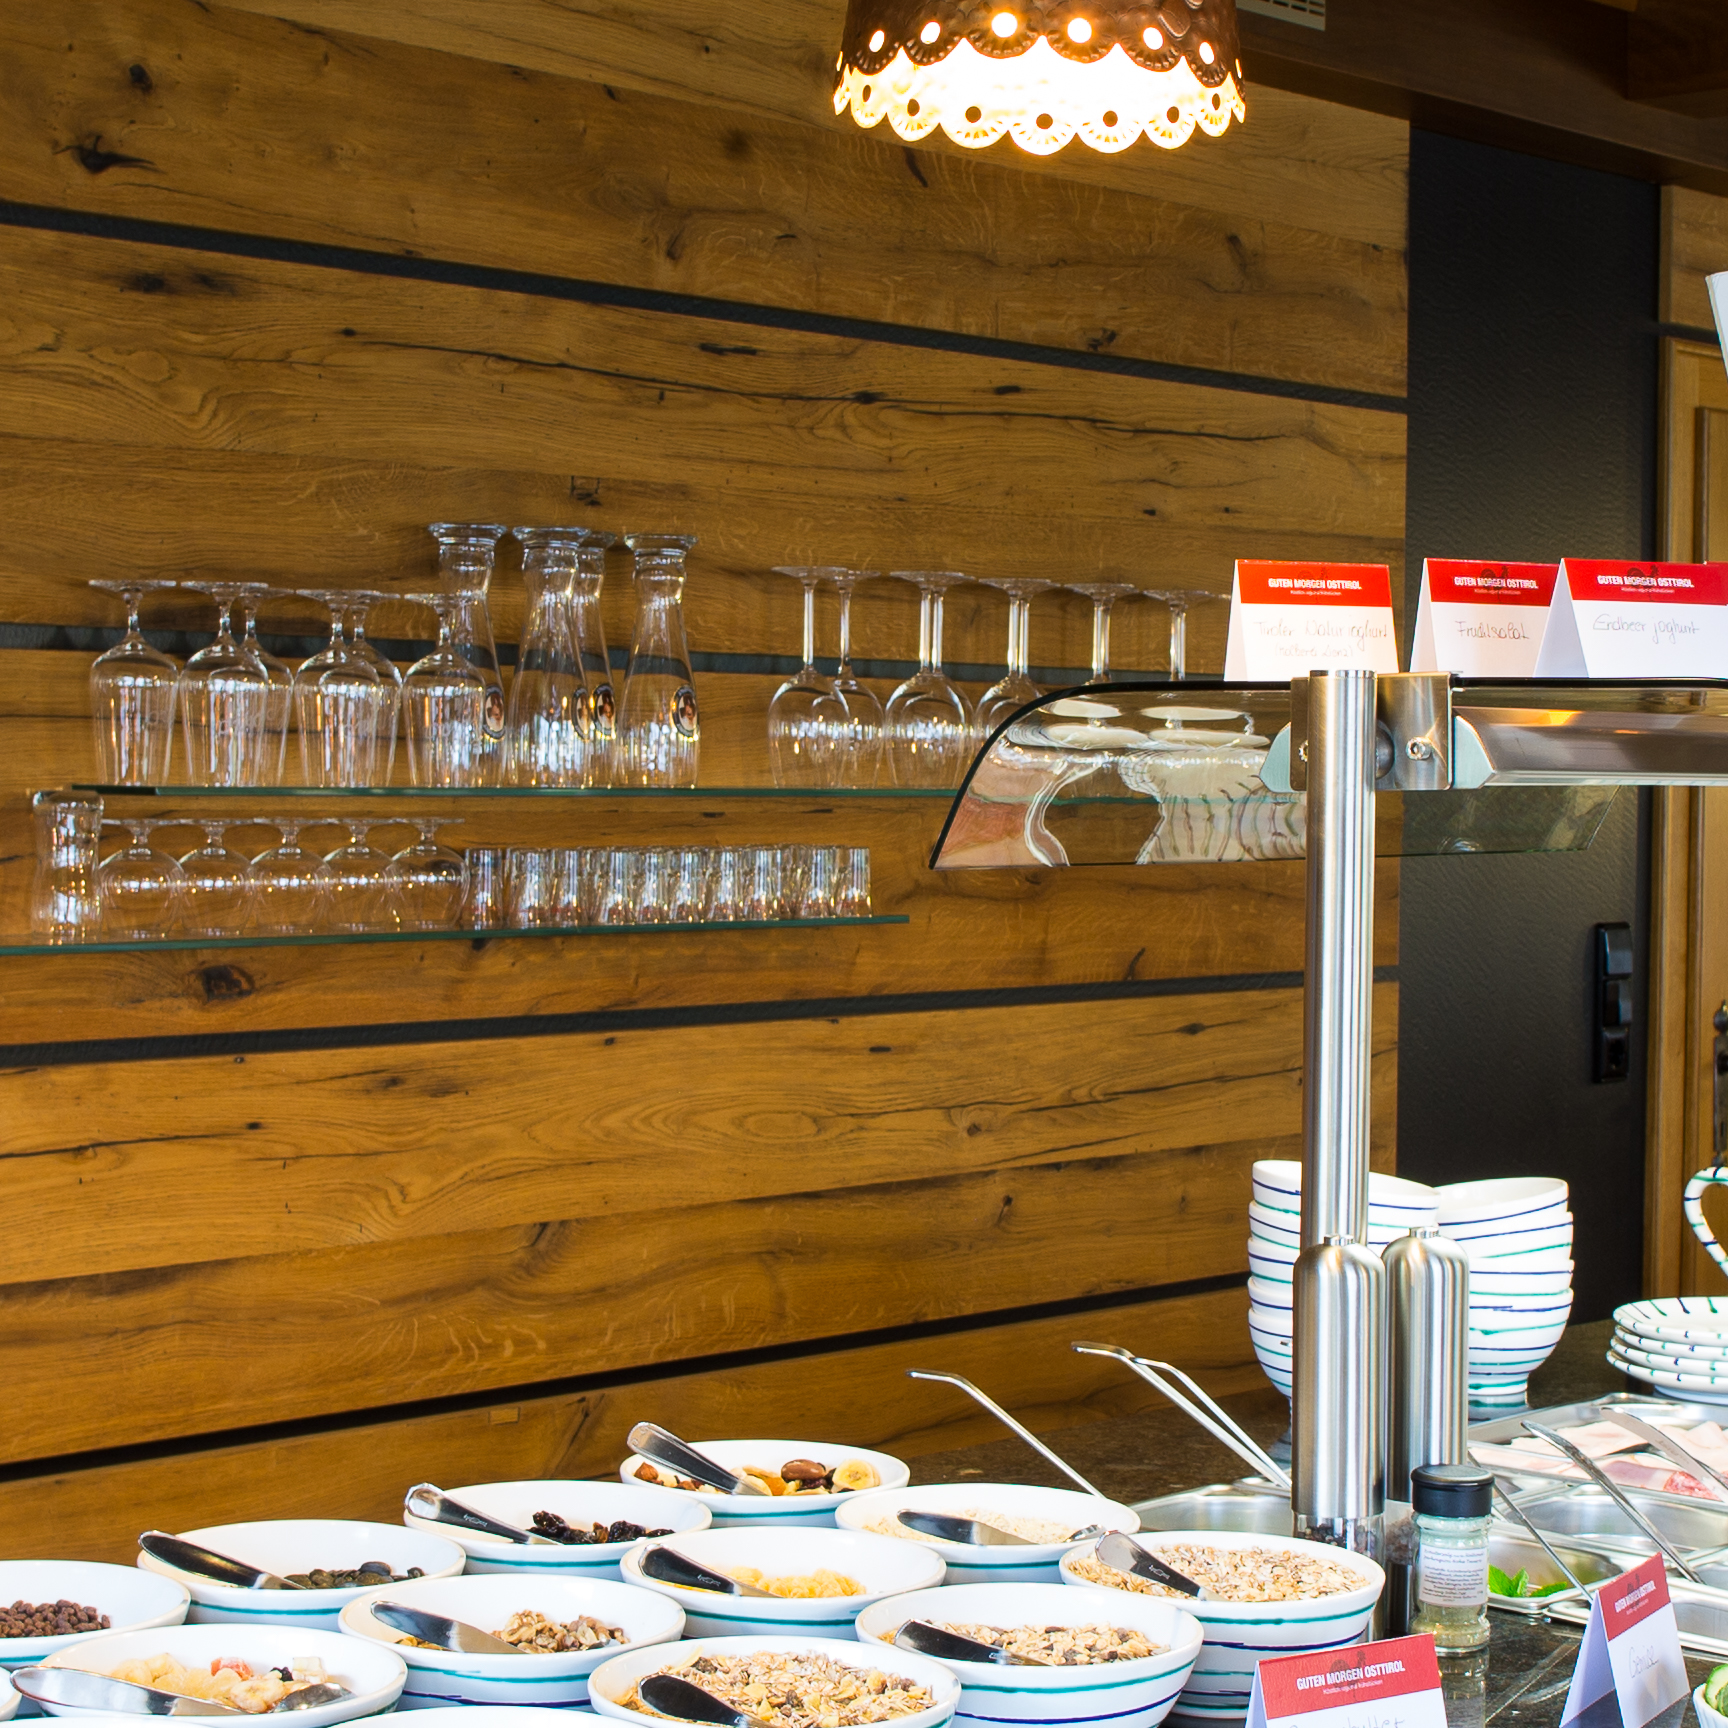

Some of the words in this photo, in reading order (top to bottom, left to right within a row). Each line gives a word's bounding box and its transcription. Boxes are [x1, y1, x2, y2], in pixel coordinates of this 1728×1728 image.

[1268, 577, 1293, 589] GUTEN
[1294, 578, 1325, 590] MORGEN
[1327, 579, 1362, 591] OSTTIROL
[1454, 576, 1477, 587] GUTEN
[1478, 577, 1506, 588] MORGEN
[1507, 579, 1539, 590] OSTTIROL
[1597, 575, 1623, 586] GUTEN
[1624, 576, 1656, 587] MORGEN
[1658, 577, 1695, 588] OSTTIROL
[1296, 1674, 1326, 1691] GUTEN
[1326, 1666, 1363, 1686] MORGEN
[1364, 1660, 1406, 1678] OSTTIROL
